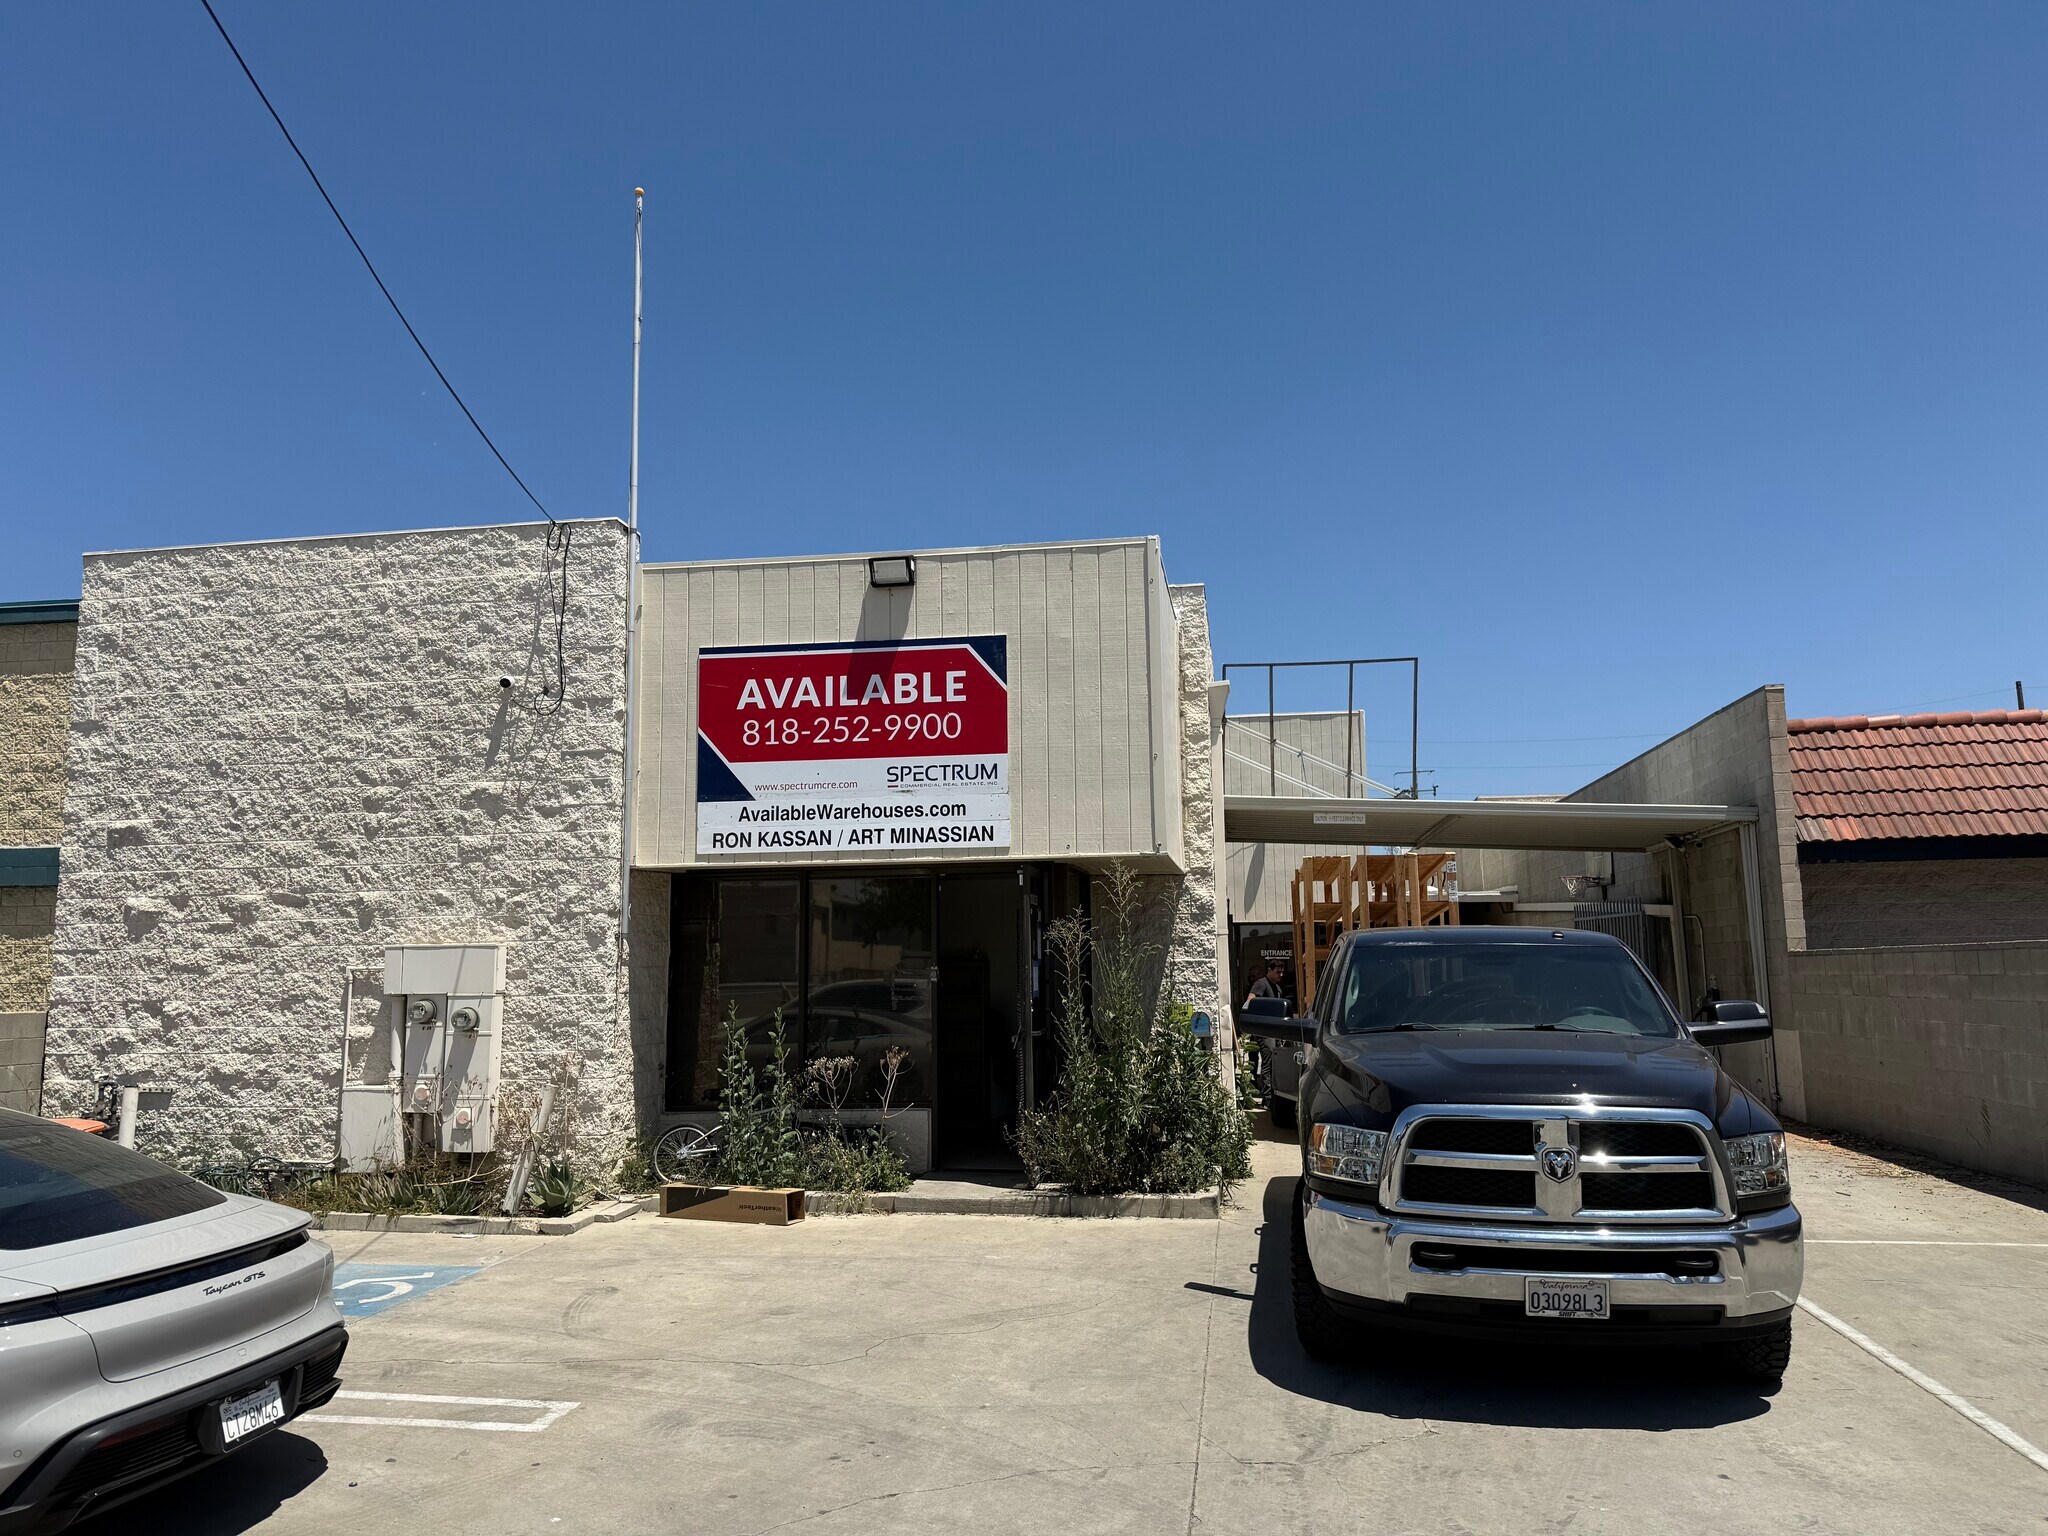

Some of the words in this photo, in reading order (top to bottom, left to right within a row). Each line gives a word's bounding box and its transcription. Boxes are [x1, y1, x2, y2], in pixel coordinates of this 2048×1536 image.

[736, 670, 967, 710] AVAILABLE
[742, 712, 962, 746] 818-252-9900
[887, 763, 998, 782] SPECTRUM
[754, 780, 858, 791] www.spectrumcre.com
[738, 803, 967, 823] AvailableWarehouses.com
[712, 831, 752, 849] RON
[757, 829, 832, 848] KASSAN
[837, 829, 844, 847] /
[848, 828, 885, 846] ART
[890, 825, 995, 844] MINASSIAN
[1261, 949, 1293, 957] ENTRANCE
[202, 1280, 242, 1296] Taycan
[243, 1270, 266, 1283] GTS
[1542, 1281, 1590, 1291] California
[1531, 1292, 1603, 1312] 03098L3
[226, 1396, 279, 1439] CT28M46
